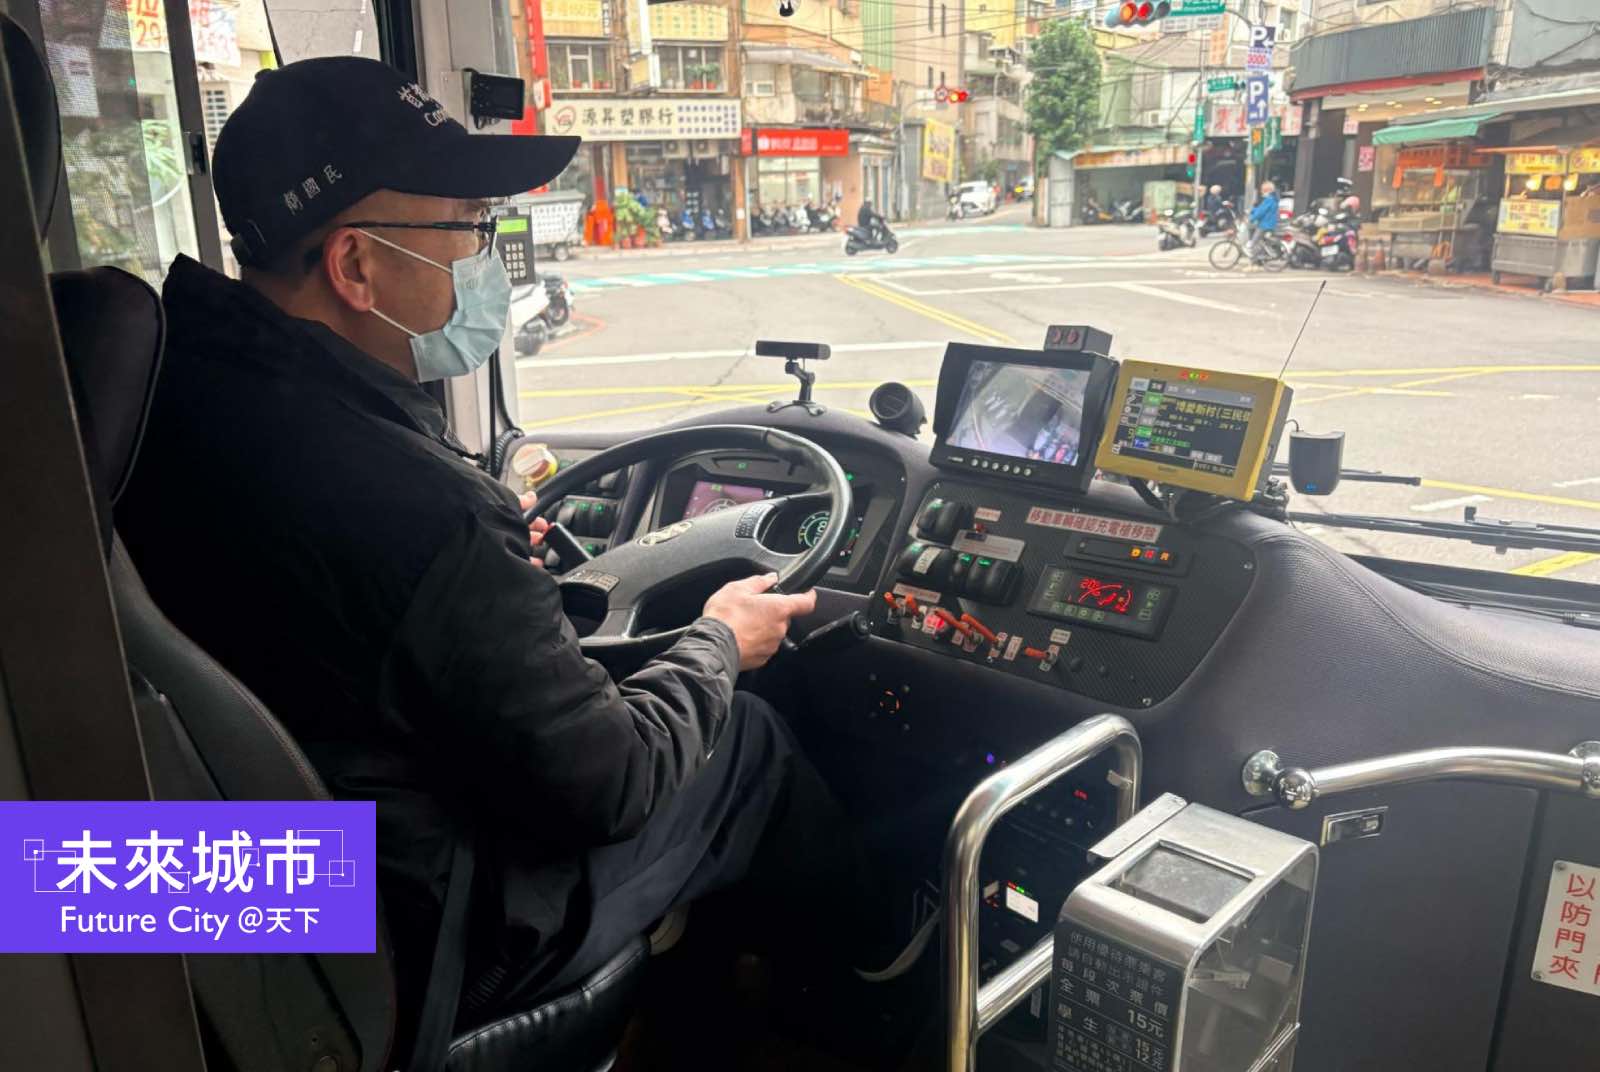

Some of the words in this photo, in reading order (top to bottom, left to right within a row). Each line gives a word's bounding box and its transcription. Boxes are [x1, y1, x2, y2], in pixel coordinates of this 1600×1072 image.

[1250, 26, 1267, 47] P
[1250, 81, 1264, 103] P
[1549, 873, 1597, 980] 以防門夾
[1127, 1009, 1164, 1039] 15元
